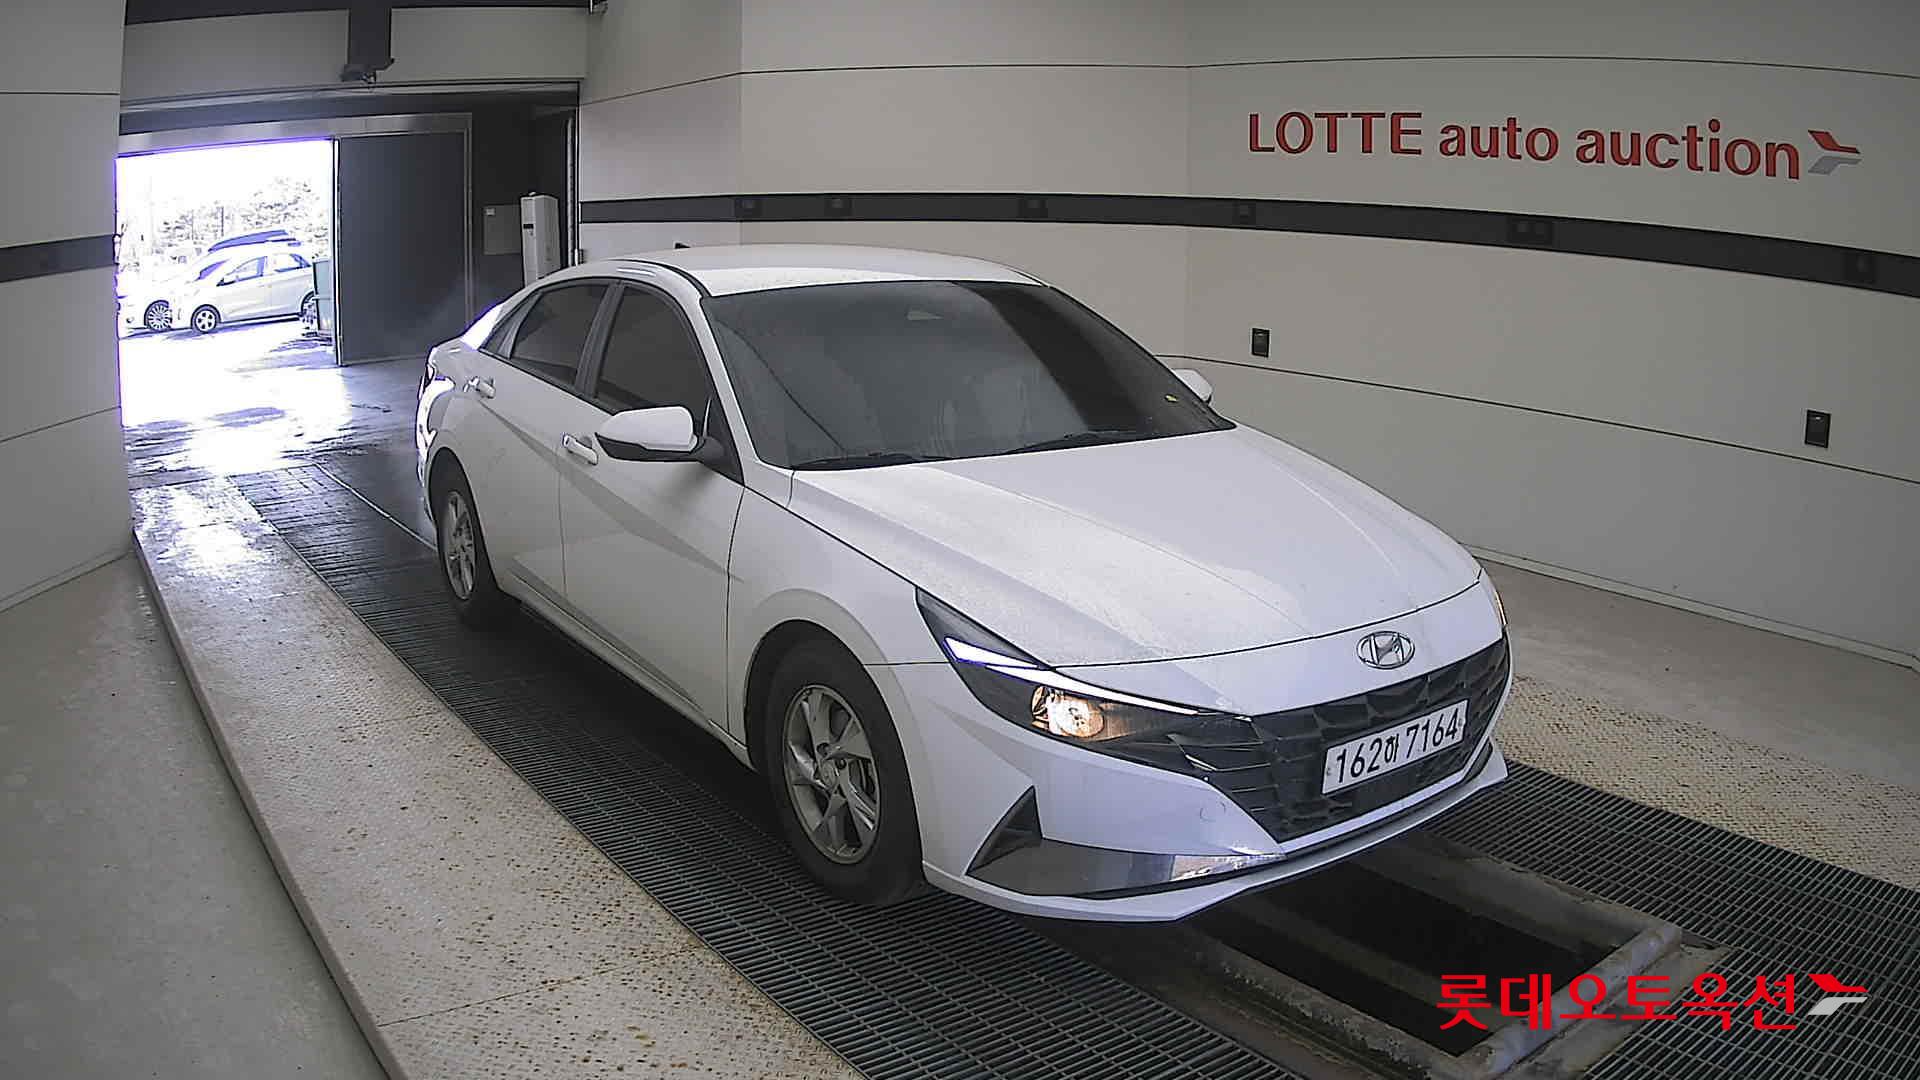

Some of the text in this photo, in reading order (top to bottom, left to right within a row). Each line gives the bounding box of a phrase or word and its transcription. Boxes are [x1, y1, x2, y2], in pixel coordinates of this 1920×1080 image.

[1249, 112, 1800, 180] LOTTE auto auction
[1336, 708, 1459, 784] 162하 7164
